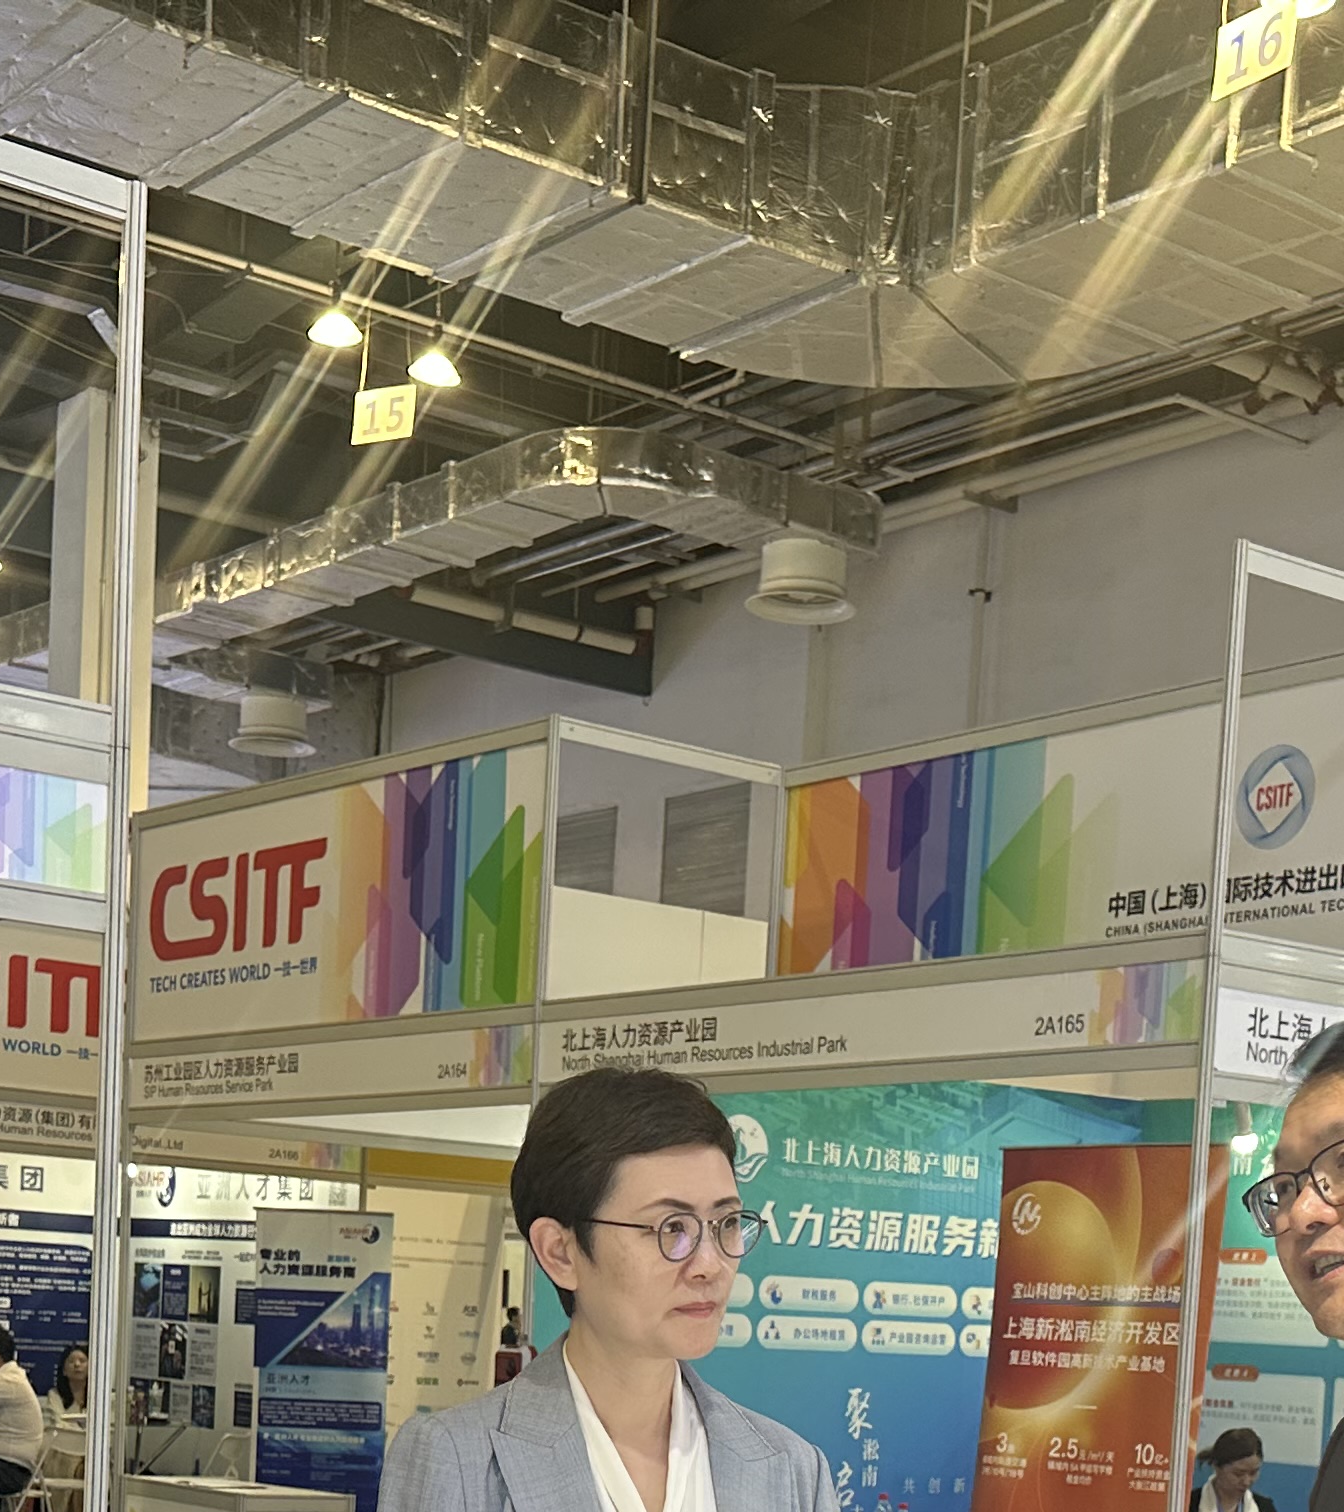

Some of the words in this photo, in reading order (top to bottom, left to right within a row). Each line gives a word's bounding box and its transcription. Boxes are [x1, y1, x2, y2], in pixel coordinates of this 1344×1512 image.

[1225, 26, 1283, 84] 16
[361, 396, 405, 435] 15
[1256, 781, 1295, 812] CSITF
[149, 836, 328, 962] CSITF
[1105, 924, 1140, 939] CHINA
[1144, 915, 1209, 936] (SHANGHAI
[1223, 903, 1316, 925] TERNATIONAL
[150, 975, 177, 994] TECH
[180, 968, 226, 990] CREATES
[229, 963, 271, 984] WORLD
[562, 1016, 719, 1055] 北上海人力资源产业园
[1034, 1014, 1086, 1039] 2A165
[2, 1038, 62, 1058] WORLD
[562, 1052, 590, 1072] North
[647, 1047, 689, 1066] Human
[691, 1043, 754, 1064] Resources
[757, 1038, 815, 1058] Industrial
[817, 1034, 848, 1054] Park
[1246, 1041, 1288, 1067] North
[158, 1084, 184, 1098] Human
[185, 1081, 224, 1096] Resources
[226, 1079, 254, 1094] Service
[256, 1077, 274, 1091] Park
[437, 1063, 468, 1081] 2A164
[37, 1126, 93, 1142] Resources
[783, 1137, 980, 1180] 北上海人力资源产业园
